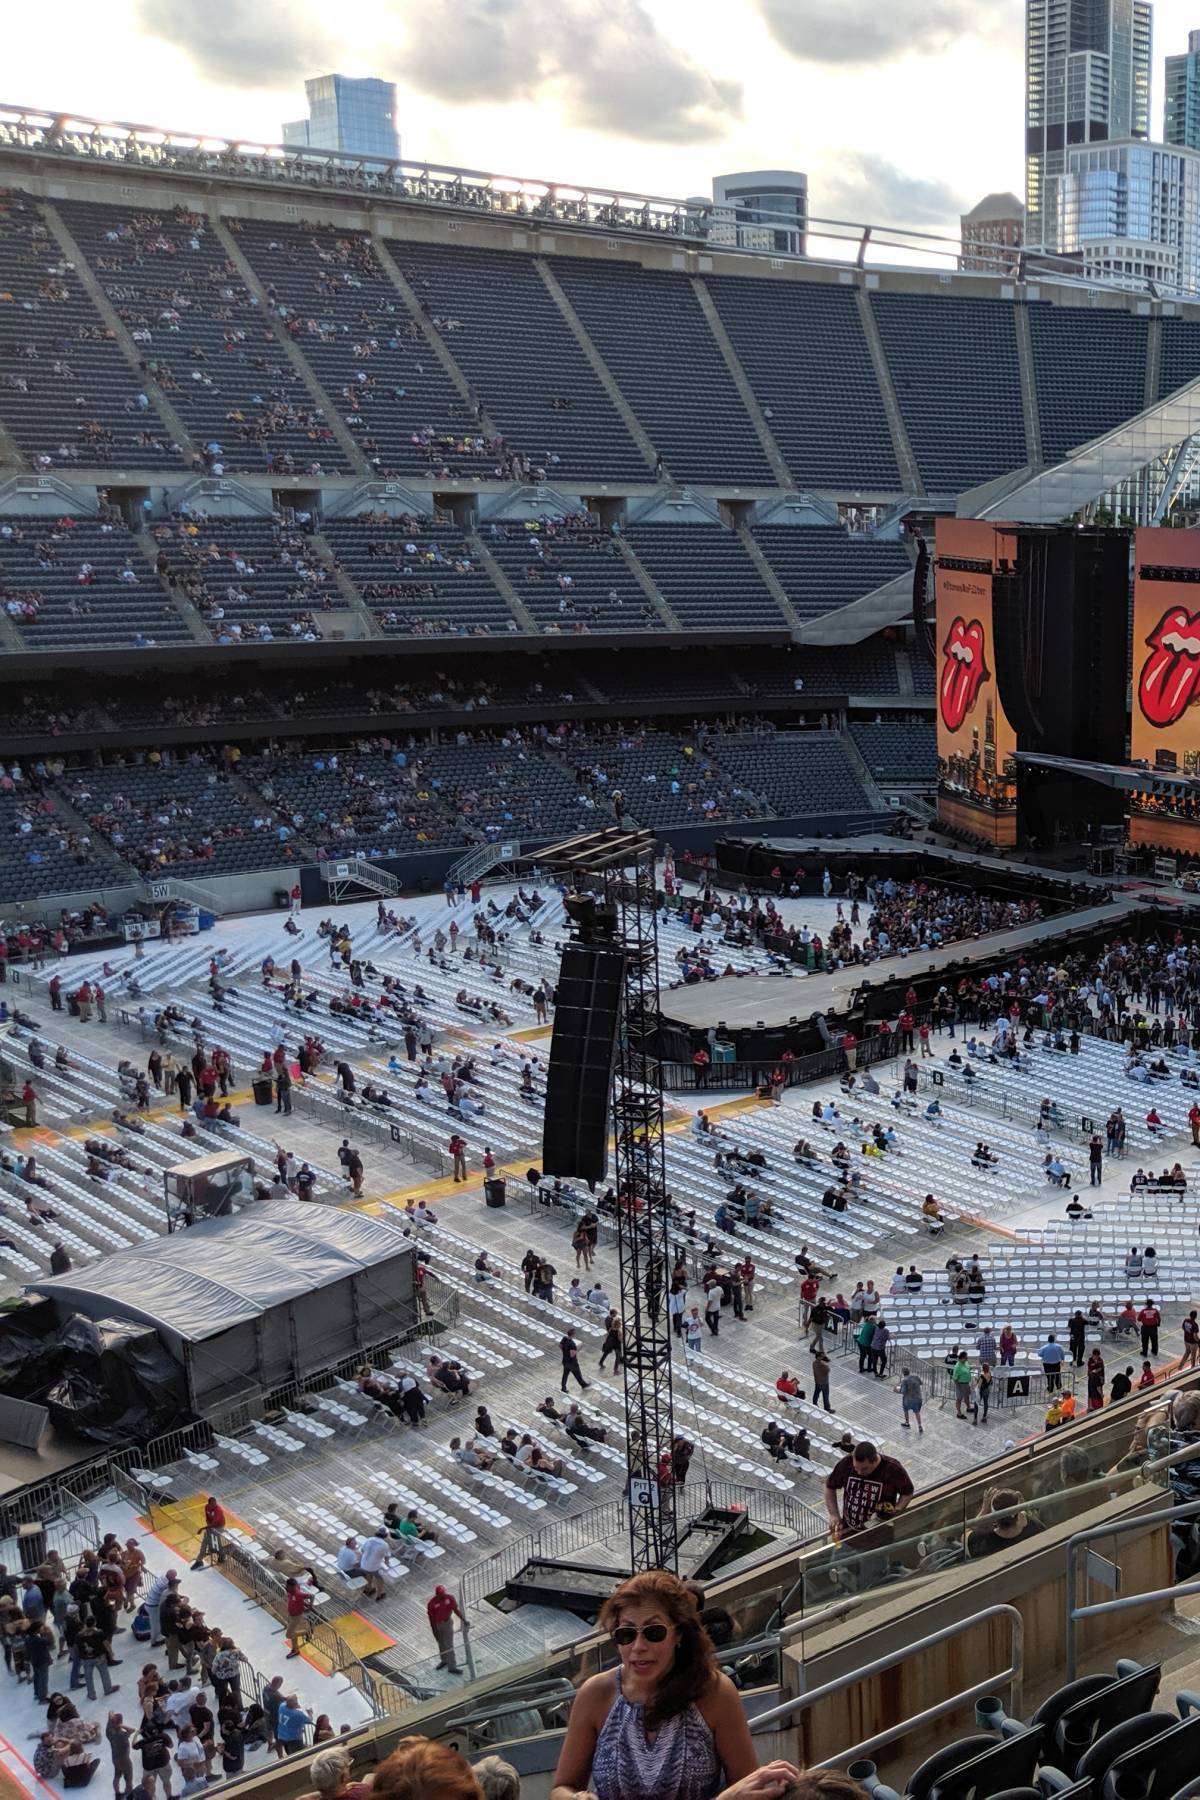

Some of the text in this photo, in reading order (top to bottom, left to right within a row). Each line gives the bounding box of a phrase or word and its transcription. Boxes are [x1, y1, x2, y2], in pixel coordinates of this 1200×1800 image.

[154, 886, 168, 898] 5W
[1012, 1380, 1024, 1394] A
[633, 1481, 648, 1490] PIT
